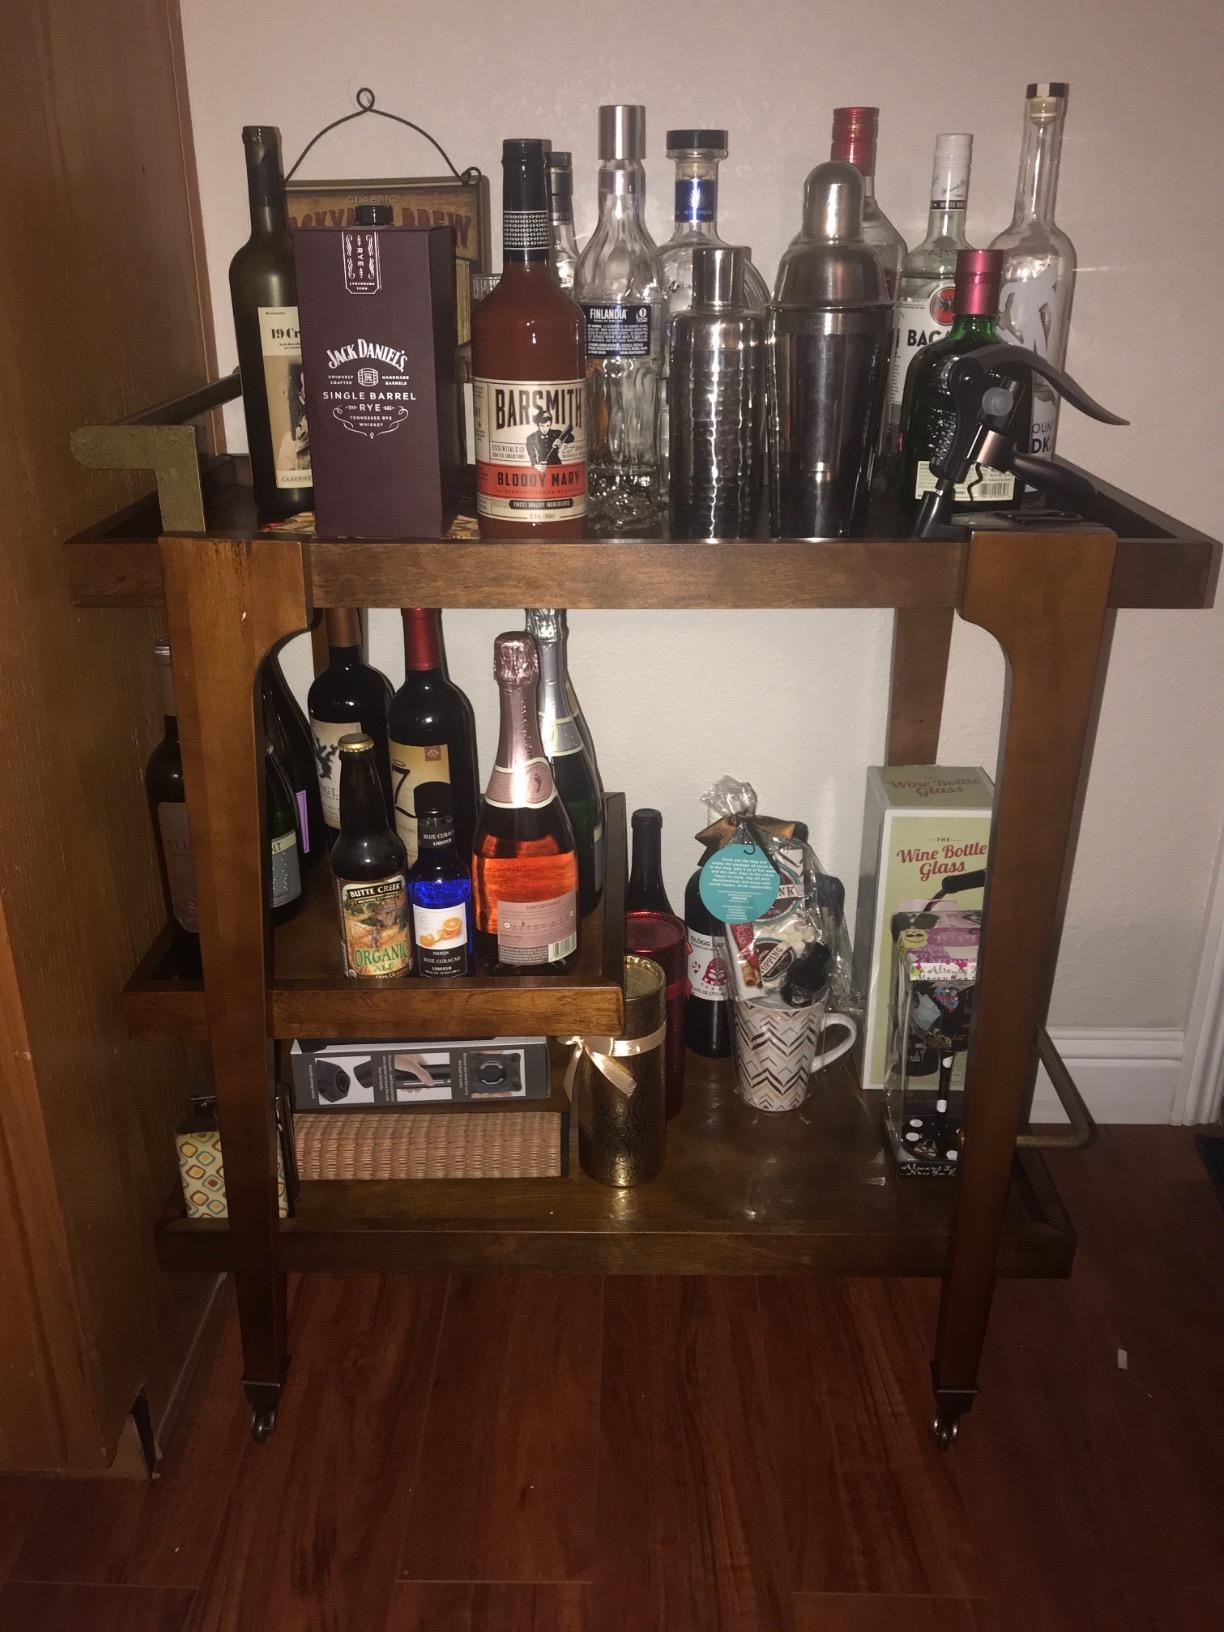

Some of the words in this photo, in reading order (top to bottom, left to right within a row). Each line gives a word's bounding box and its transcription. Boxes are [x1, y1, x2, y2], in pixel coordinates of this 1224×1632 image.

[355, 247, 365, 268] RYE
[590, 308, 627, 320] FINLANDIA
[271, 328, 285, 339] 19
[907, 329, 951, 347] BAC
[326, 343, 358, 369] JACK
[357, 338, 408, 373] DANIEL'S
[322, 391, 366, 400] SINGLE
[369, 392, 417, 401] BARREL
[359, 403, 381, 412] RYE
[495, 388, 582, 430] BARSMITH
[497, 471, 546, 487] BLOODY
[551, 471, 579, 487] MARY
[896, 848, 939, 864] Wine
[942, 841, 988, 859] Bottle
[919, 860, 966, 882] Glass
[349, 887, 376, 899] BUTTE
[377, 882, 402, 893] CREEK
[760, 946, 784, 974] OPPING
